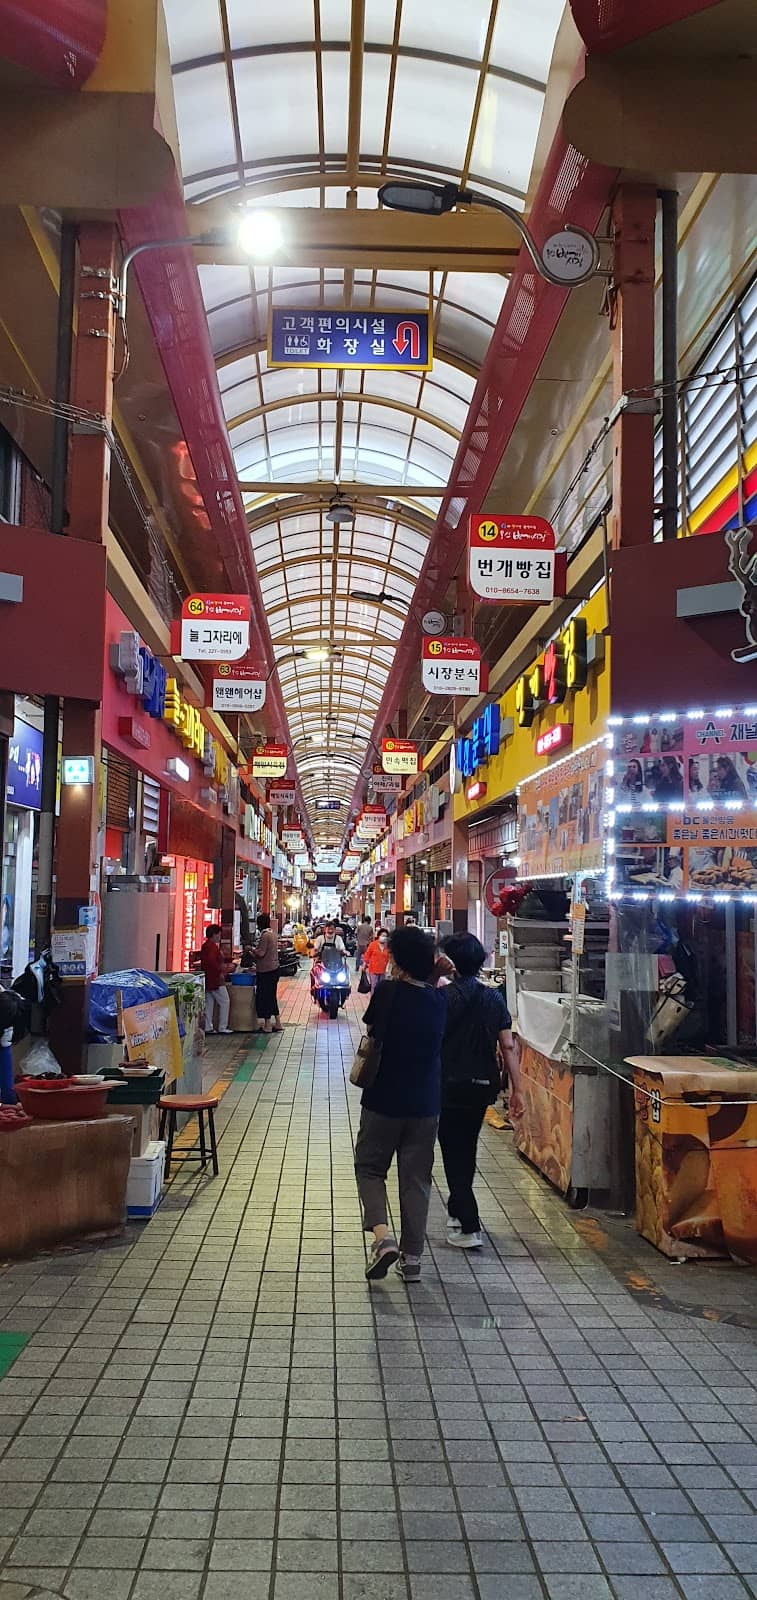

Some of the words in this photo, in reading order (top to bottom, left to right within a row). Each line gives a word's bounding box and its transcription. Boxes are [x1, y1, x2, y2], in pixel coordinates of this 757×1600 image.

[281, 316, 385, 335] 고객편의시설
[480, 525, 496, 537] 14
[478, 559, 551, 579] 번개빵집
[189, 601, 202, 612] 64
[189, 628, 199, 642] 늘
[202, 630, 242, 645] 그자리에
[430, 643, 441, 652] 15
[219, 665, 230, 674] 63
[427, 666, 478, 681] 시장분식
[730, 722, 757, 741] 채널
[673, 829, 698, 840] 좋은날
